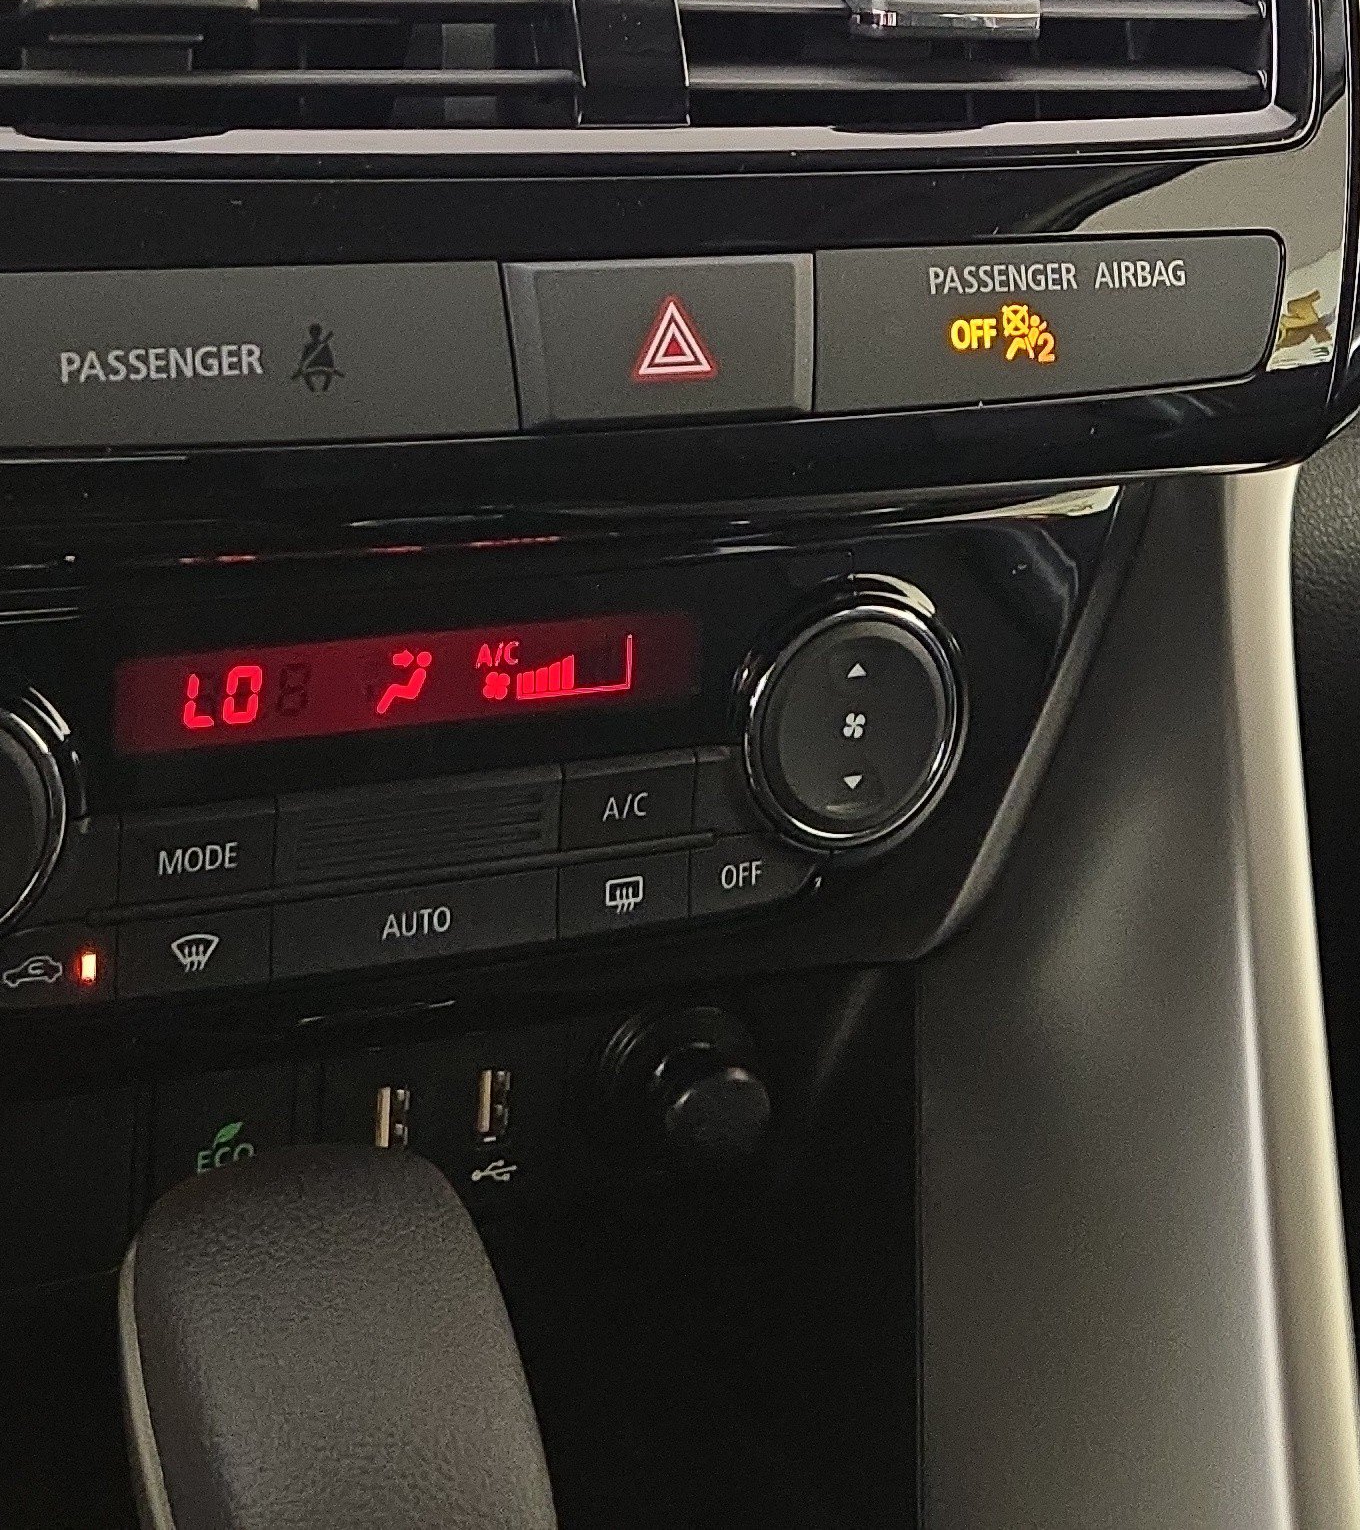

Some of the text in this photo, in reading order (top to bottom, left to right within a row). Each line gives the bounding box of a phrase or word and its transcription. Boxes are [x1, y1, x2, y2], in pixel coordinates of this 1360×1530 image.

[928, 259, 1187, 296] PASSENGER AIRBAG
[950, 317, 998, 351] OFF
[59, 343, 264, 385] PASSENGER
[474, 641, 520, 669] A/C
[601, 791, 649, 822] A/C
[158, 841, 239, 876] MODE
[720, 860, 764, 891] OFF
[381, 906, 452, 941] AUTO
[197, 1142, 255, 1174] ECO
